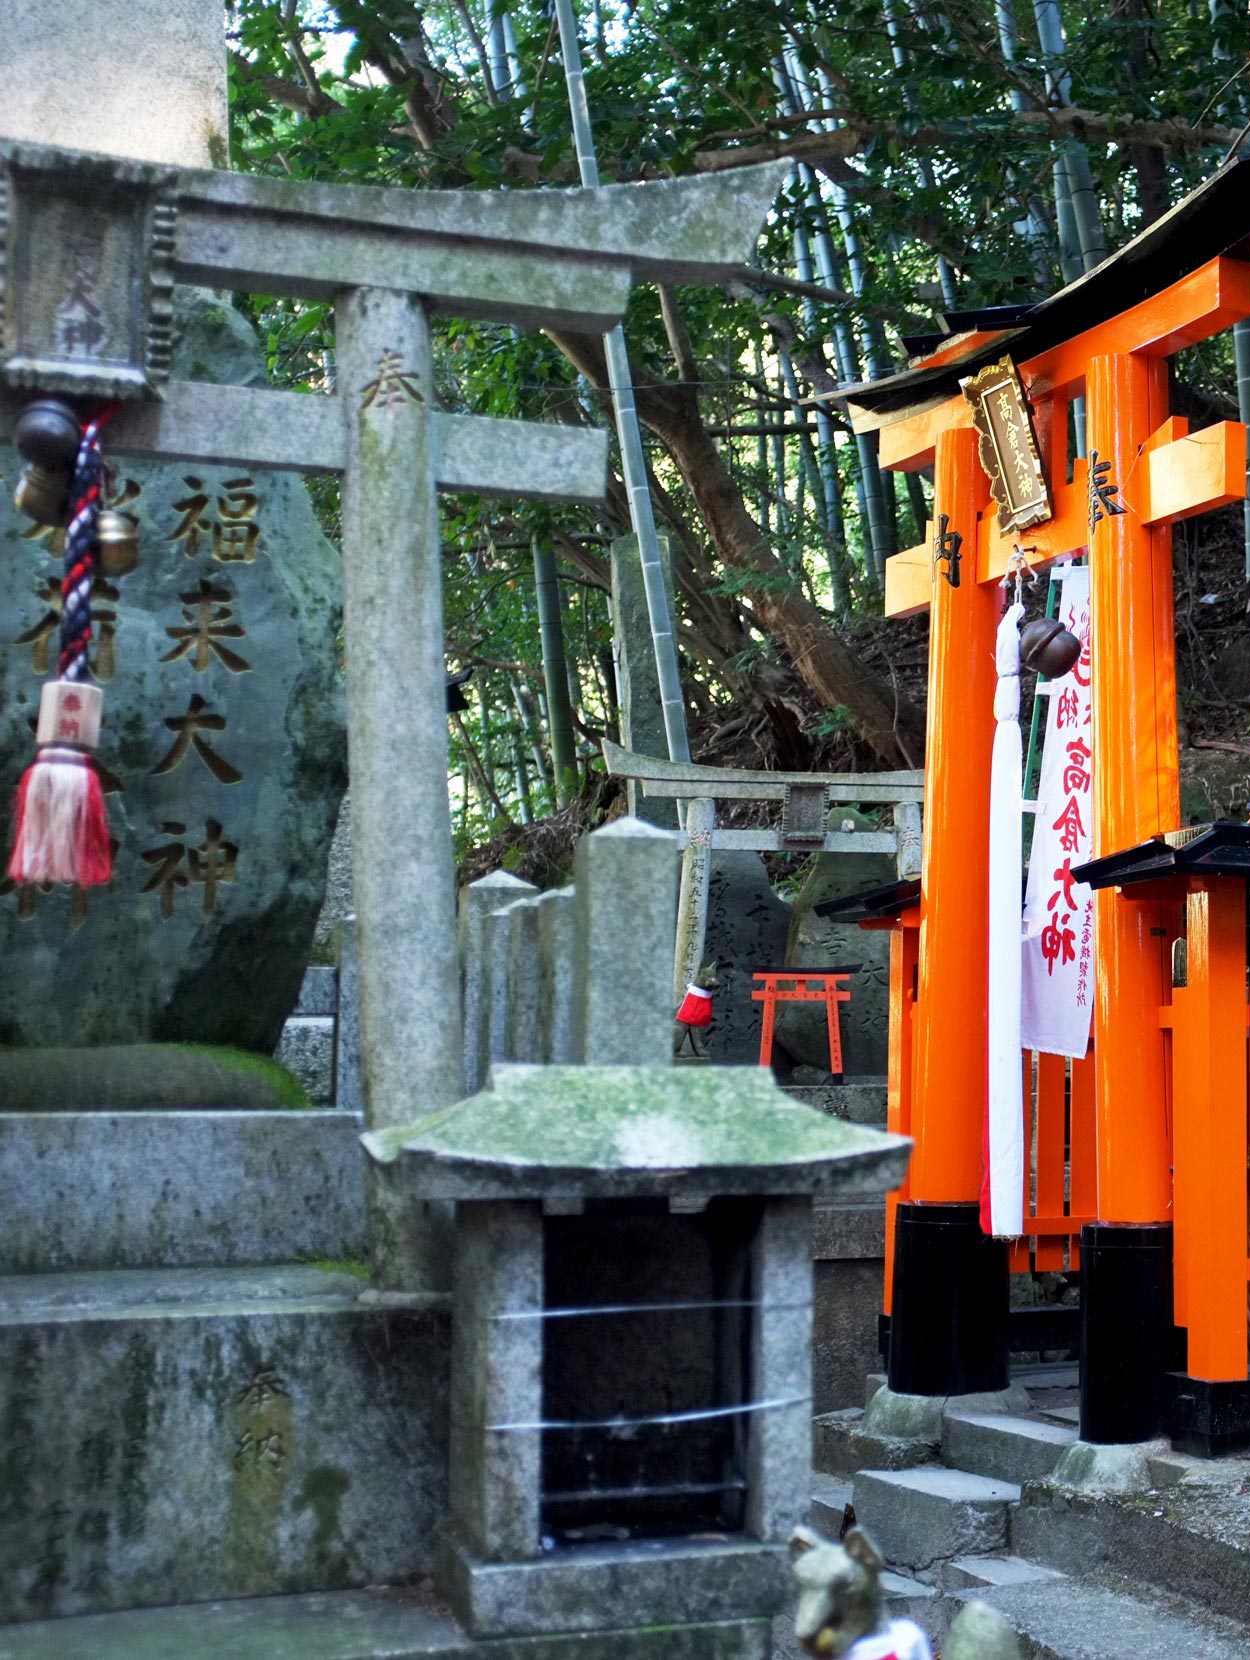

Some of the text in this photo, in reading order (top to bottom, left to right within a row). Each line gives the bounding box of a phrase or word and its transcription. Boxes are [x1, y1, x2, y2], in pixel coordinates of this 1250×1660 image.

[359, 346, 424, 410] 奉
[139, 475, 262, 925] 福来大神
